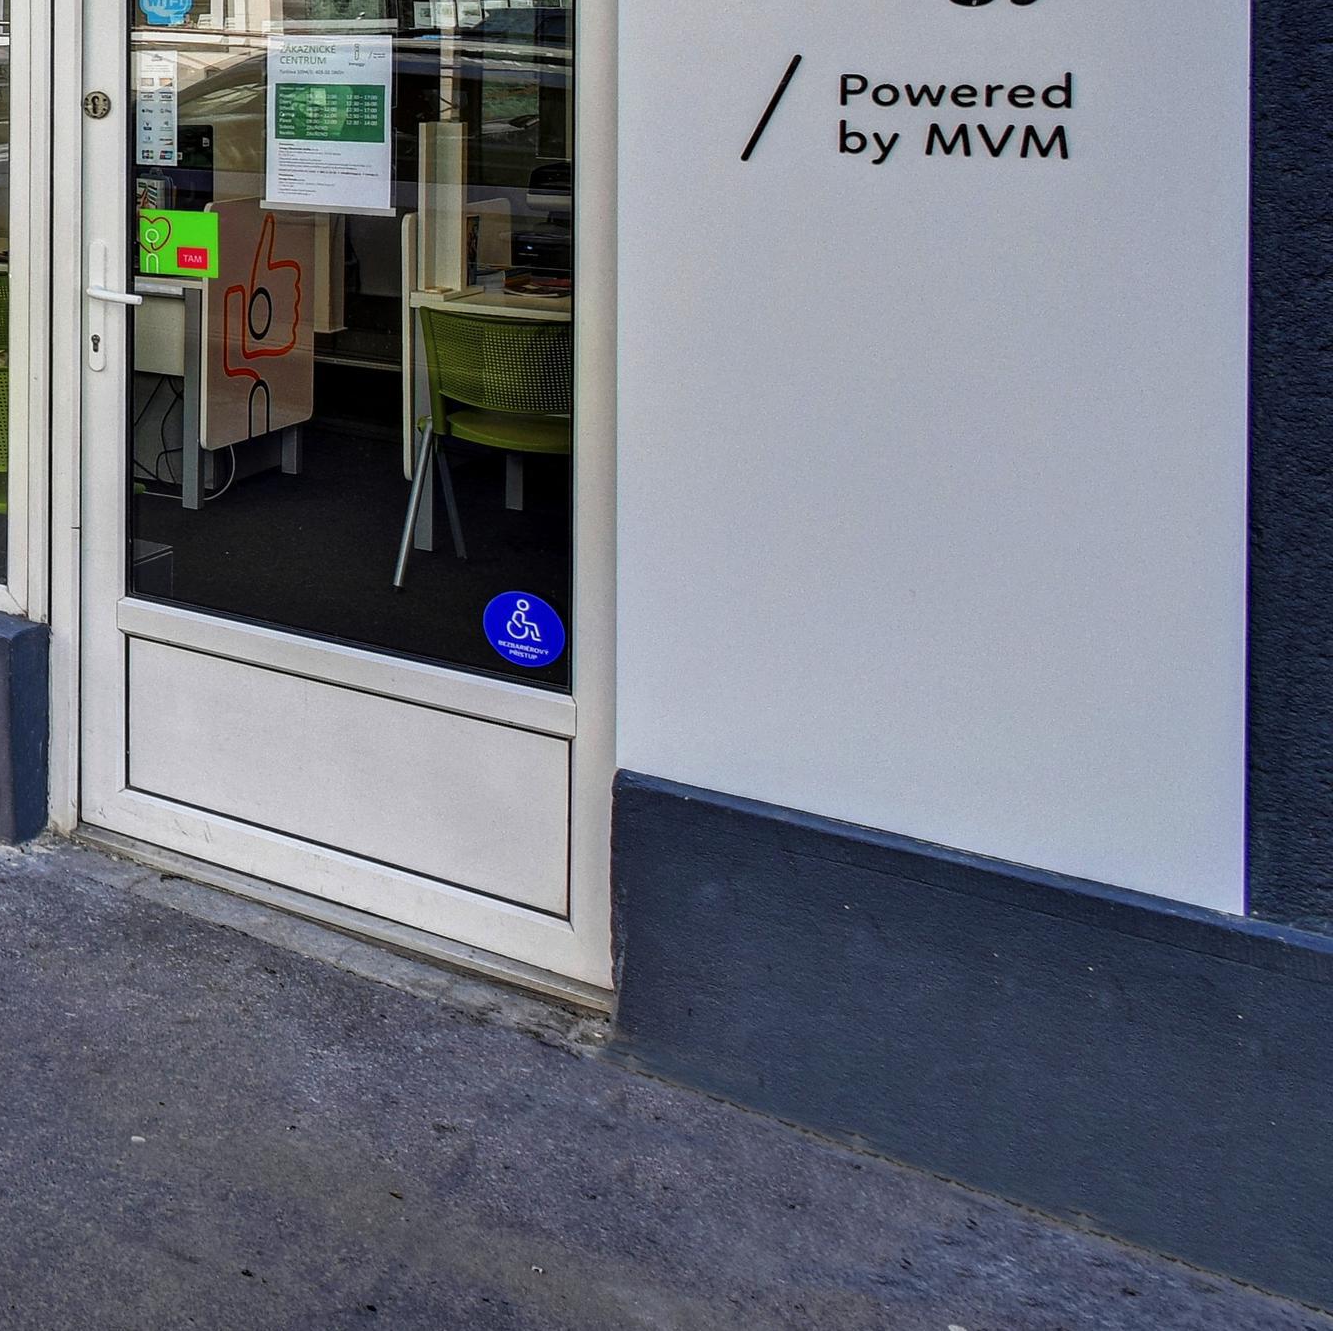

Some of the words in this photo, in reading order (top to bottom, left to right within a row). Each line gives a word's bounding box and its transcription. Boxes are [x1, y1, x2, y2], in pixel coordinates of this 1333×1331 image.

[279, 55, 327, 65] CENTRUM
[839, 71, 1074, 110] Powered
[837, 119, 900, 165] by
[925, 123, 1070, 161] MVM
[182, 254, 203, 264] TAM
